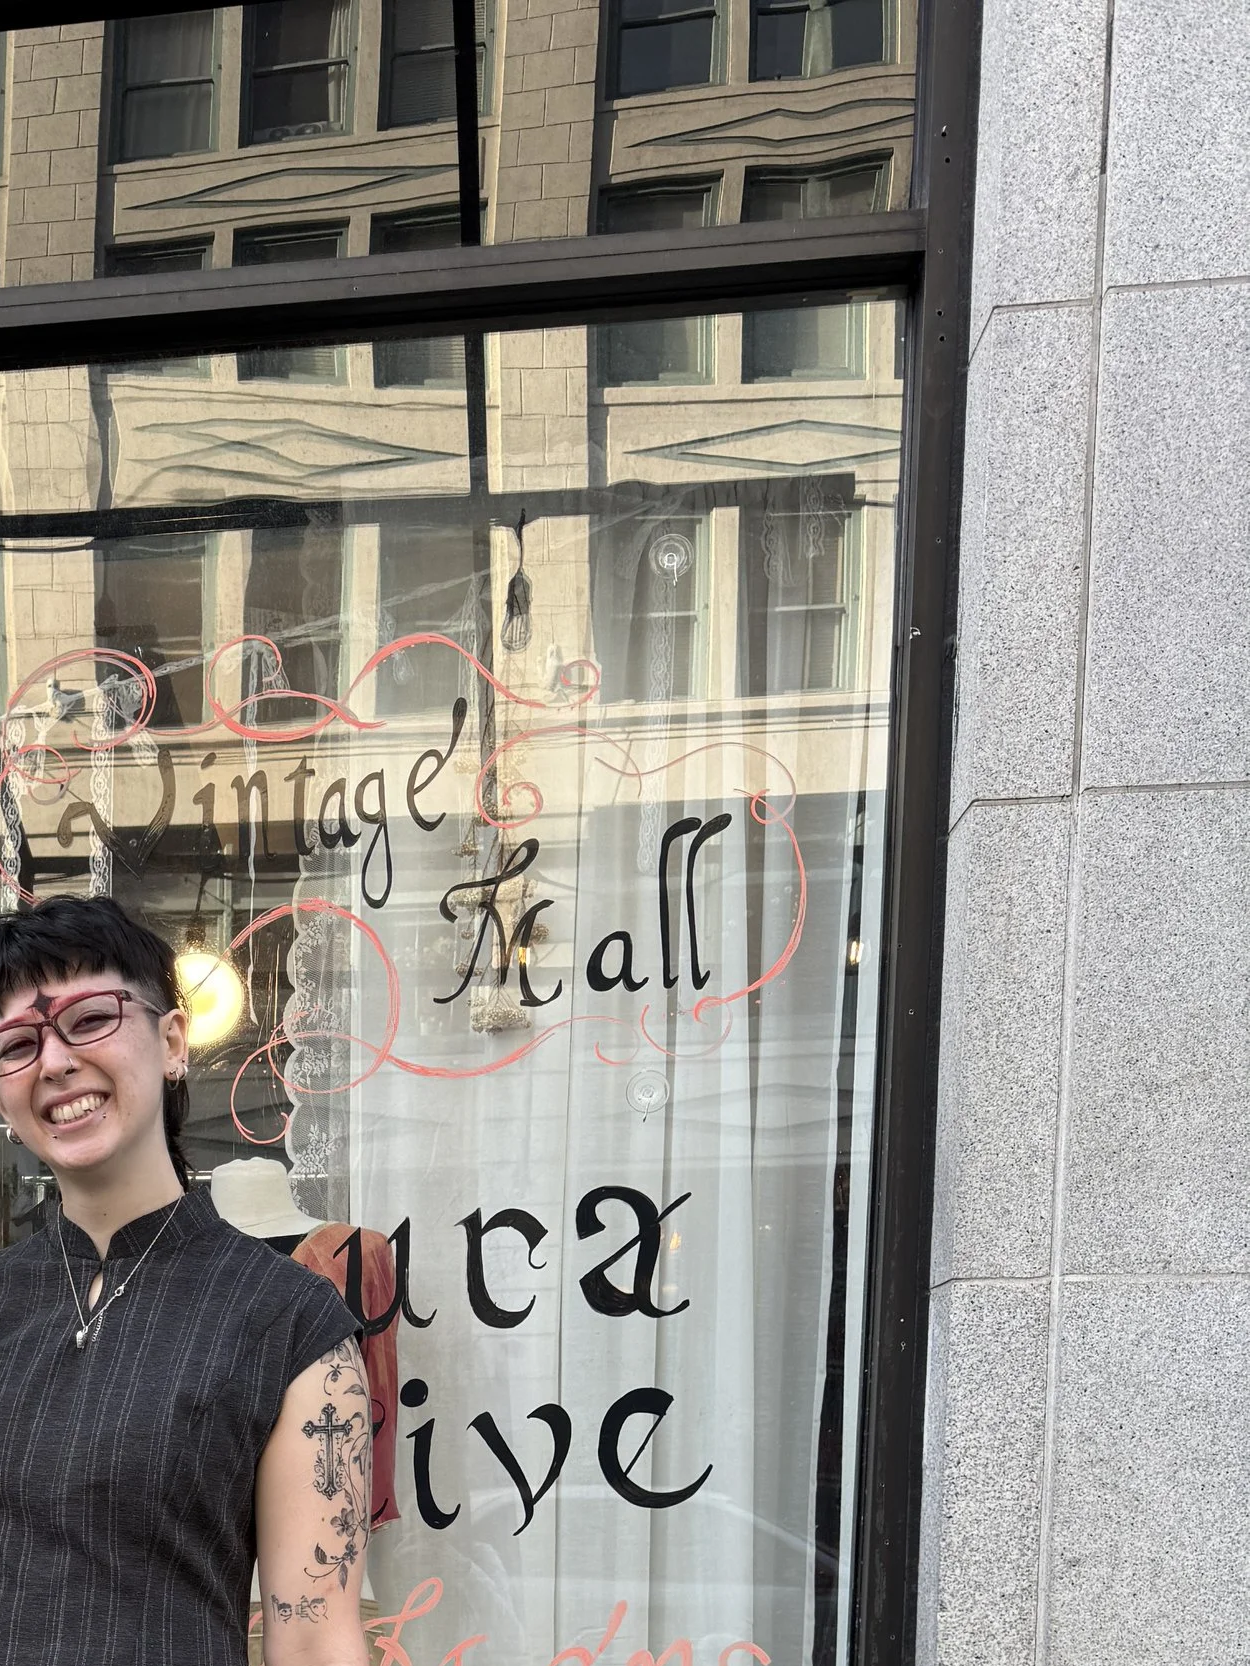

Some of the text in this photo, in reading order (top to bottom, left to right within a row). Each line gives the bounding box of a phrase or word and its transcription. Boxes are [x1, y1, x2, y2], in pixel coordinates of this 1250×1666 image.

[56, 697, 468, 910] Vintage
[434, 813, 732, 1008] Mall
[333, 1185, 691, 1337] ura
[371, 1387, 713, 1537] ive
